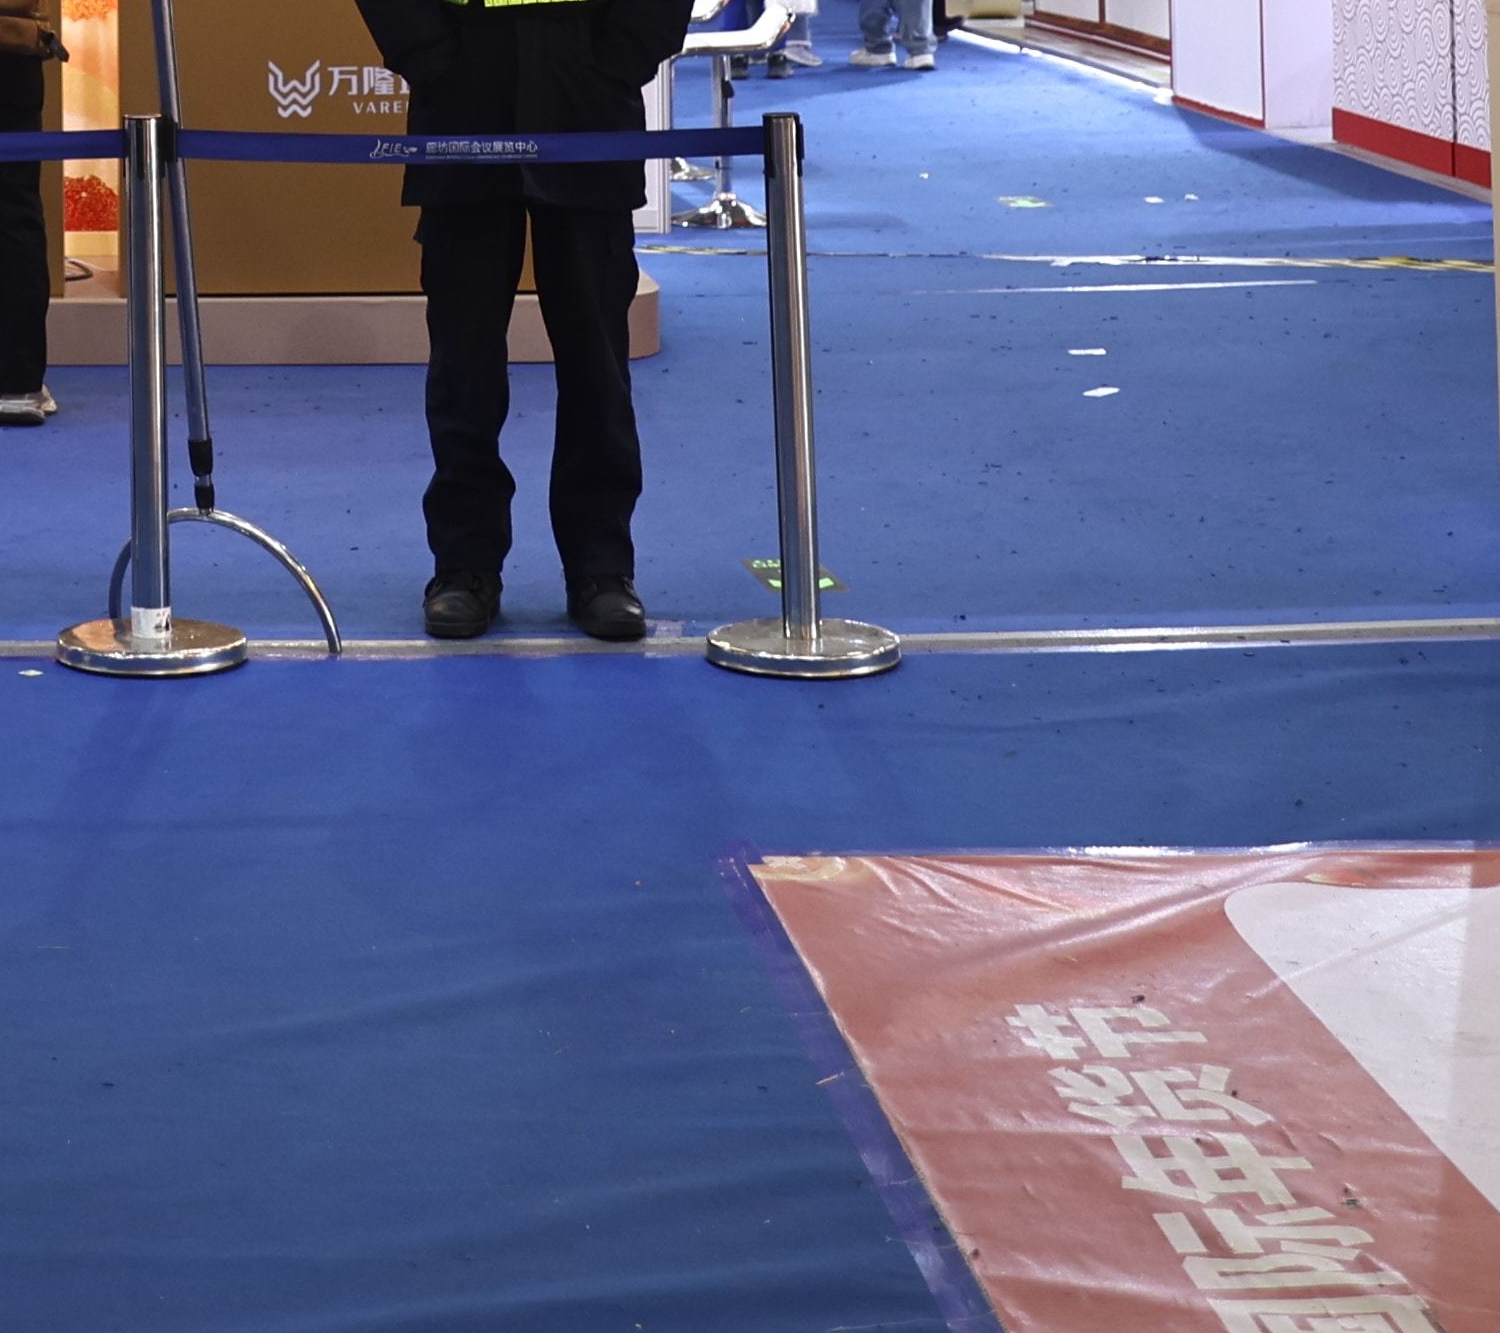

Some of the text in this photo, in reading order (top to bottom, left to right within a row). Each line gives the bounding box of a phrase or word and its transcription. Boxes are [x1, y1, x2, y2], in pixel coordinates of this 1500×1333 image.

[425, 139, 538, 154] 廊坊国际会议展览中心
